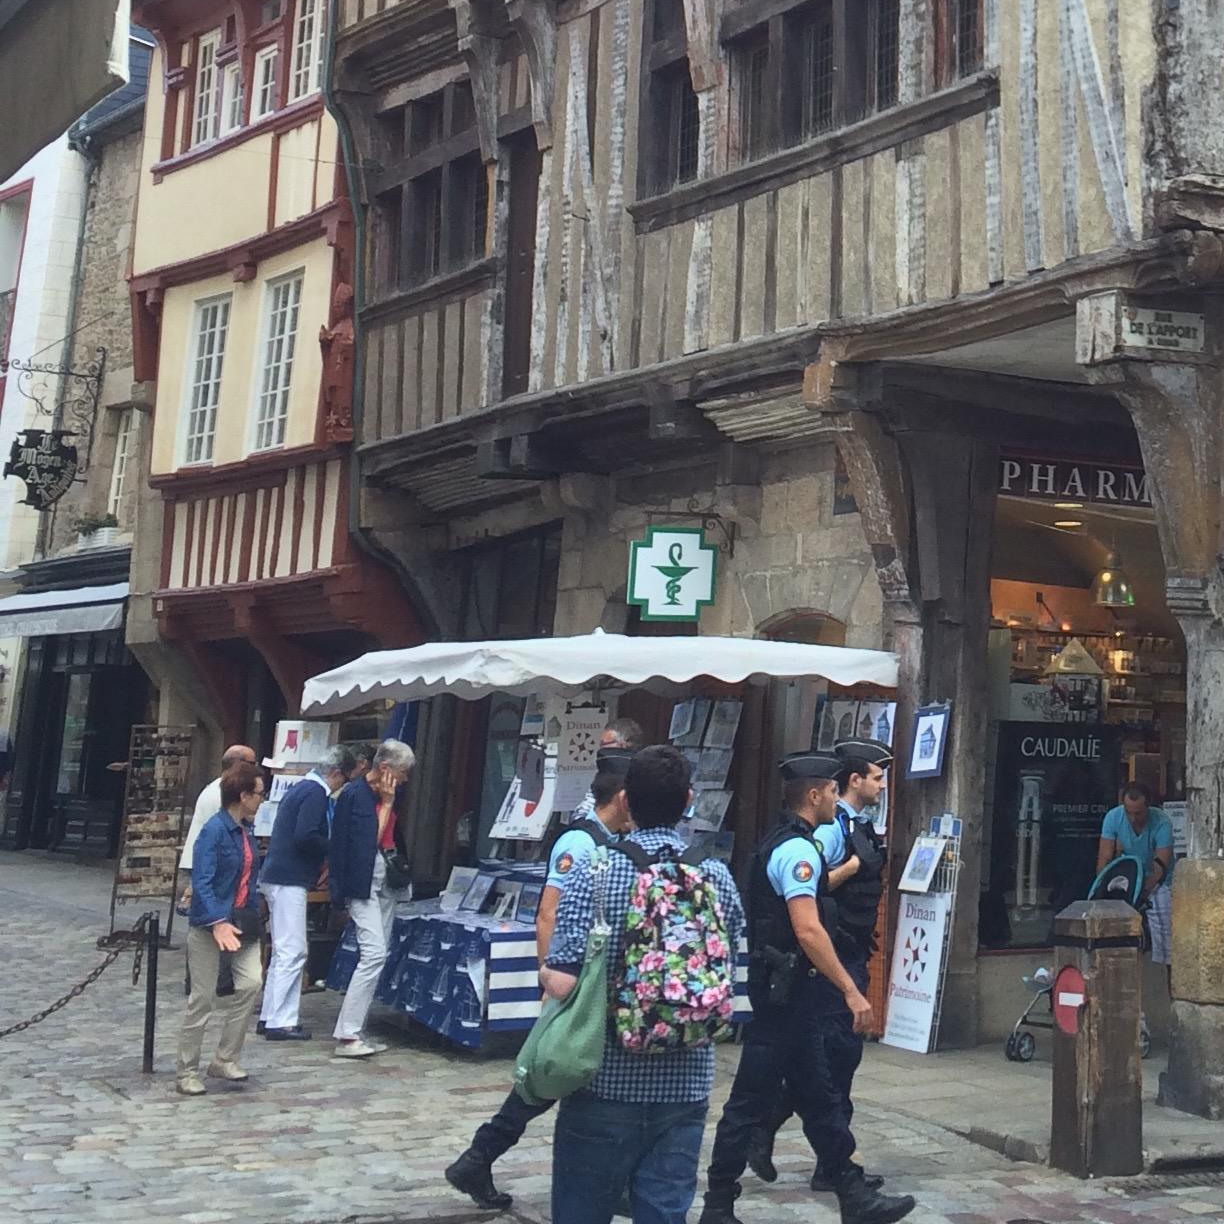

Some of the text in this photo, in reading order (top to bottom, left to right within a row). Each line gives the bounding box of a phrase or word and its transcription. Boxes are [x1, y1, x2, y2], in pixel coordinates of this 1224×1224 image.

[1130, 322, 1144, 335] DE
[566, 720, 601, 731] Dinan
[905, 902, 936, 922] Dinan
